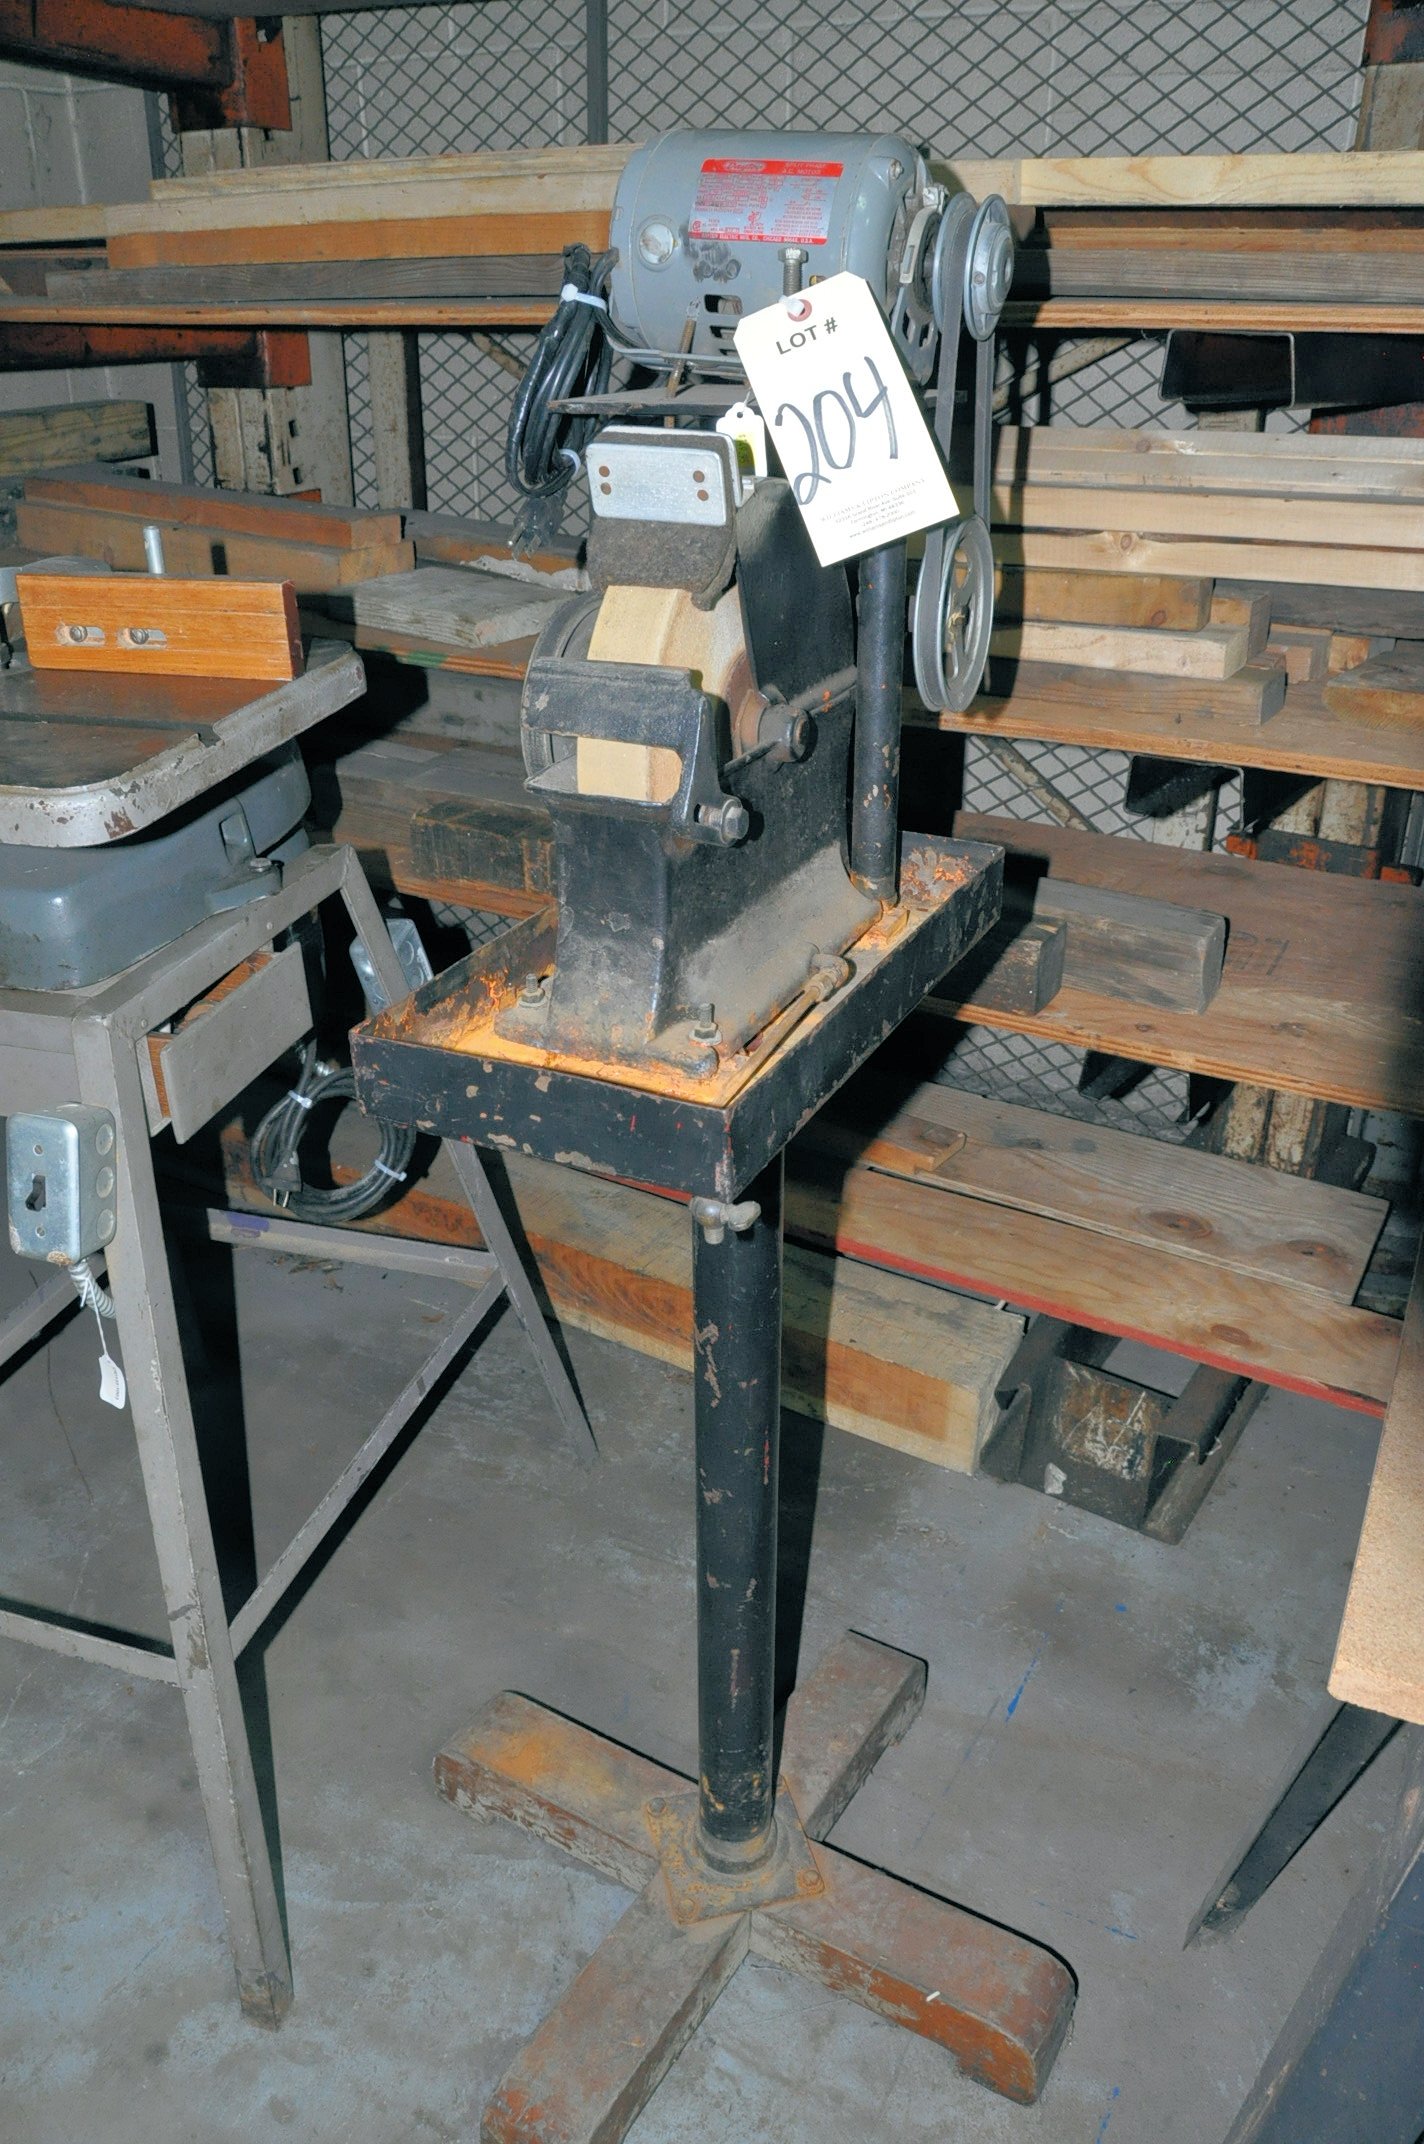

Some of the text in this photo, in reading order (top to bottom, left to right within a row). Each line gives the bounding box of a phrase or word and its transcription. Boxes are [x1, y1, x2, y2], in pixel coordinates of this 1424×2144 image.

[775, 316, 838, 356] LOT #
[775, 356, 898, 505] 204
